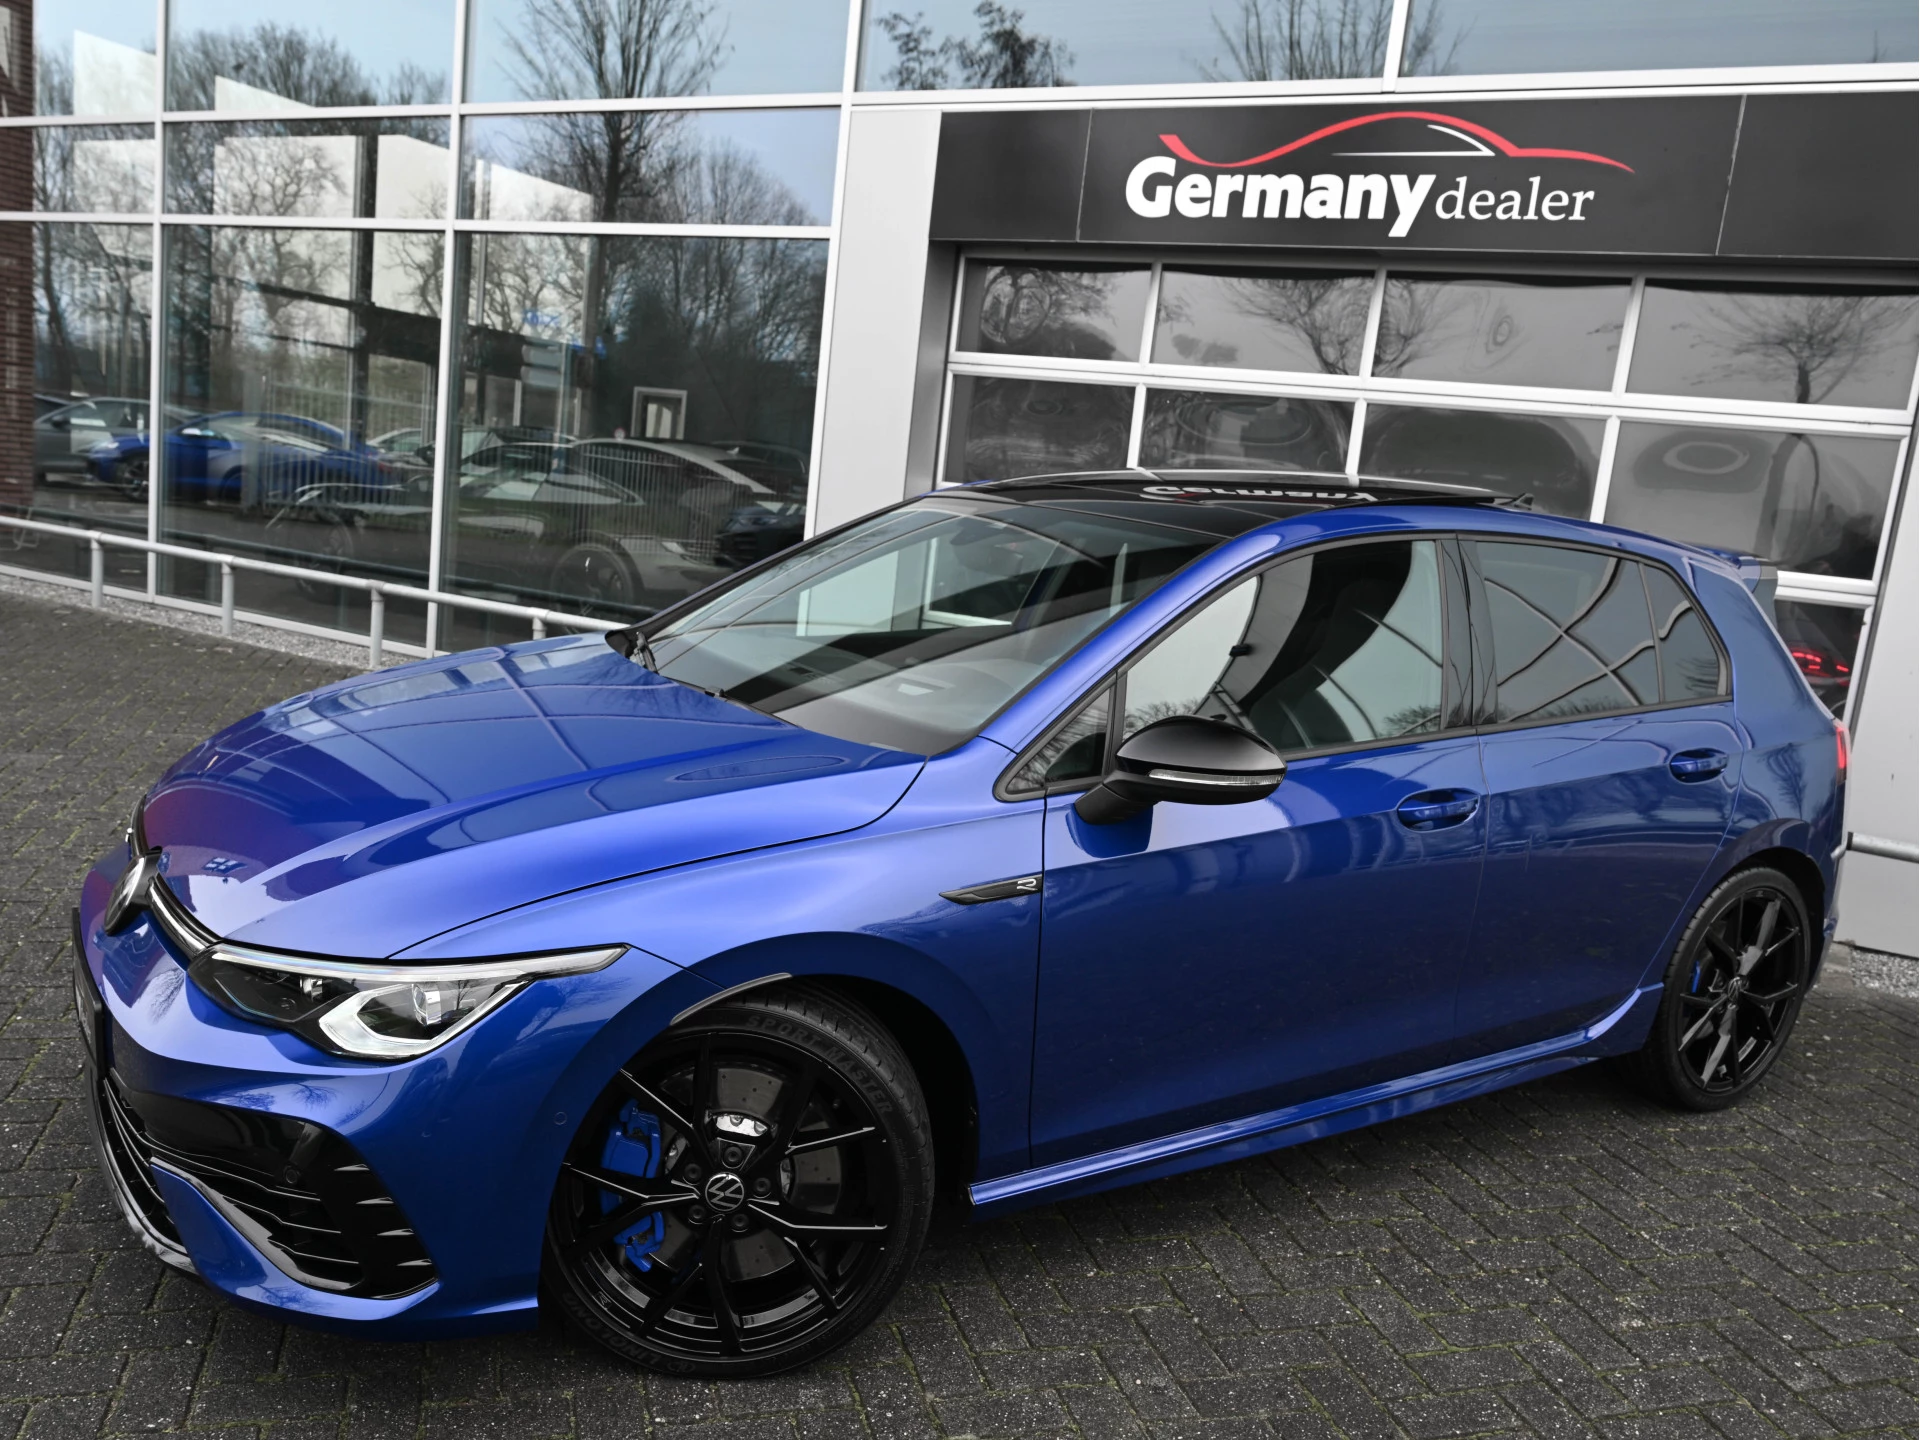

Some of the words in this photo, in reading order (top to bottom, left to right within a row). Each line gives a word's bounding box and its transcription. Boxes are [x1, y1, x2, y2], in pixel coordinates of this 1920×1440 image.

[1125, 155, 1436, 237] Germany
[1435, 176, 1595, 221] dealer
[1016, 878, 1038, 891] R
[745, 1014, 821, 1049] SPORT
[825, 1046, 894, 1114] MASTER
[562, 1292, 662, 1365] LINGLONG
